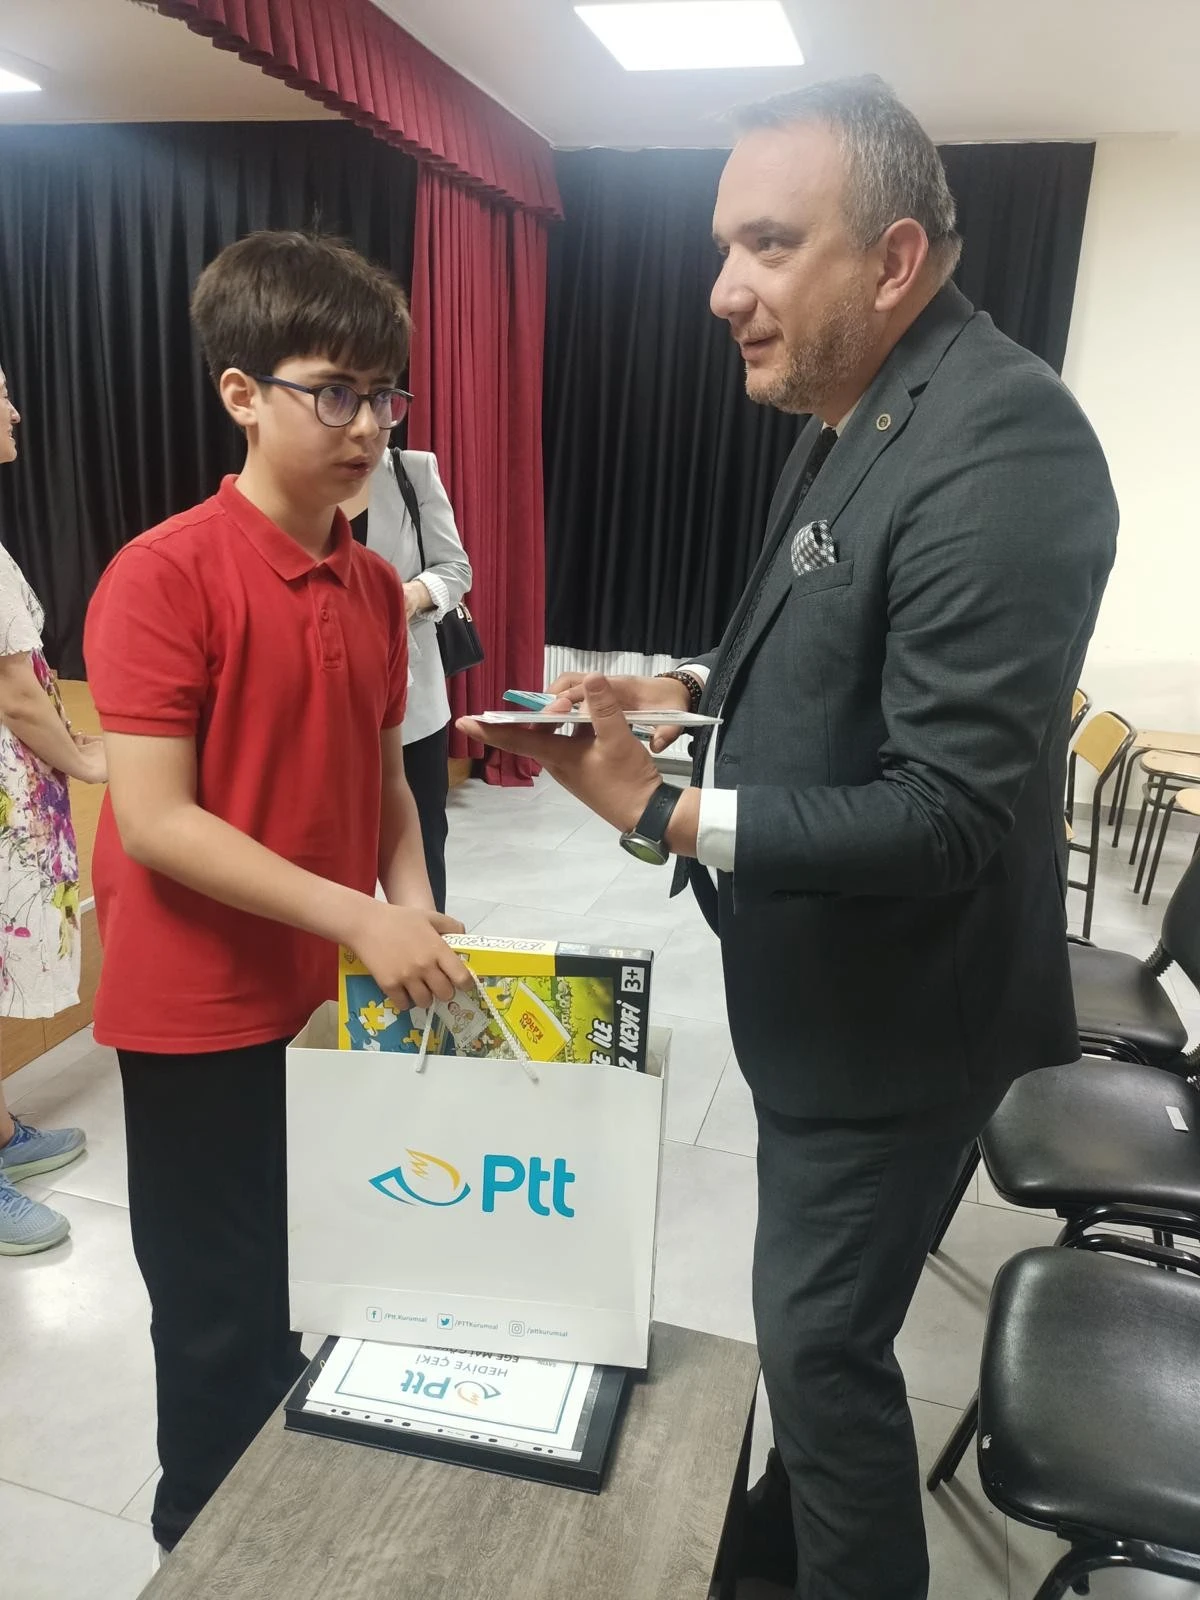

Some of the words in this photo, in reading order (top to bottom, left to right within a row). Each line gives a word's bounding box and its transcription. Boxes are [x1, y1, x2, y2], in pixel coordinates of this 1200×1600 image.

[624, 969, 641, 990] 3+
[587, 1018, 613, 1050] İLE
[616, 999, 641, 1053] KEYFİ
[481, 1154, 576, 1218] Ptt
[415, 1353, 450, 1367] ÇEKİ
[455, 1360, 508, 1378] HEDİYE
[400, 1369, 452, 1400] Ptt
